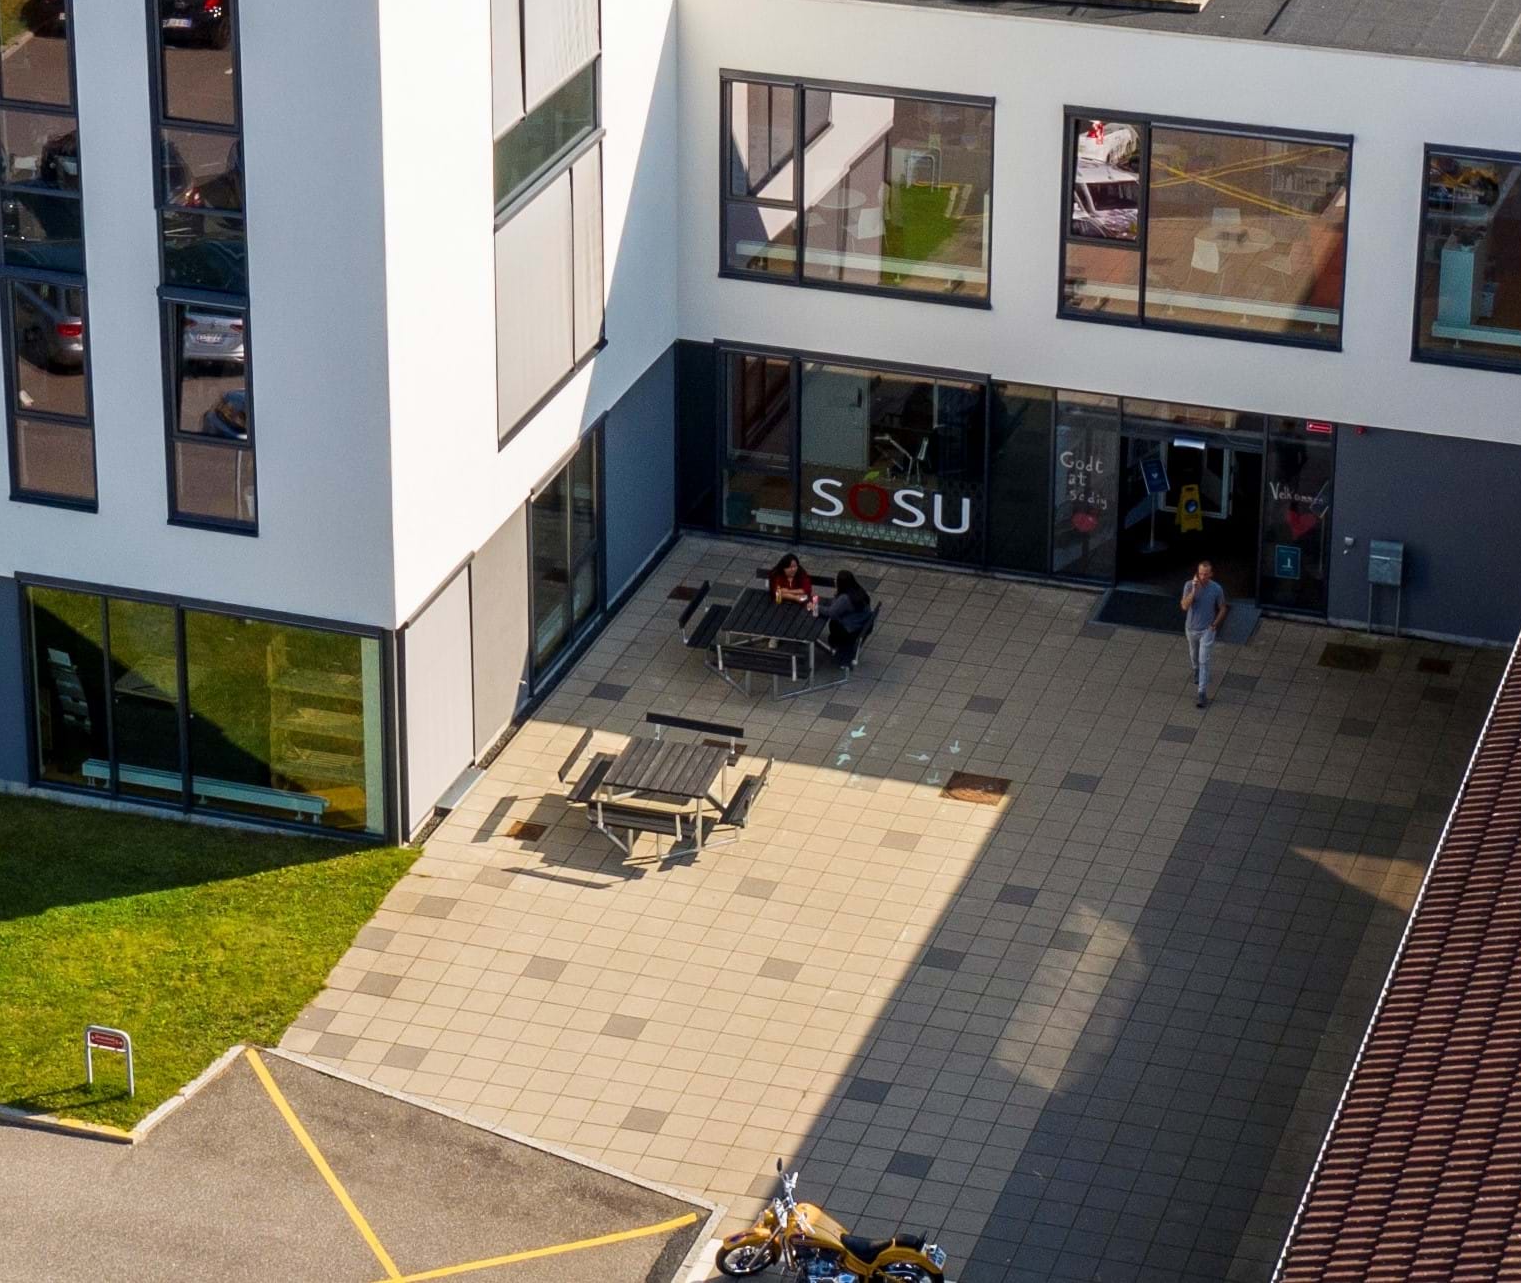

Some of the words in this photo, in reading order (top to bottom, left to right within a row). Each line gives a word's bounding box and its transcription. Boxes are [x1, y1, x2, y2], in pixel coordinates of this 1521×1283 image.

[1060, 451, 1104, 473] Godt
[1068, 472, 1087, 486] at
[810, 477, 971, 534] SOSU
